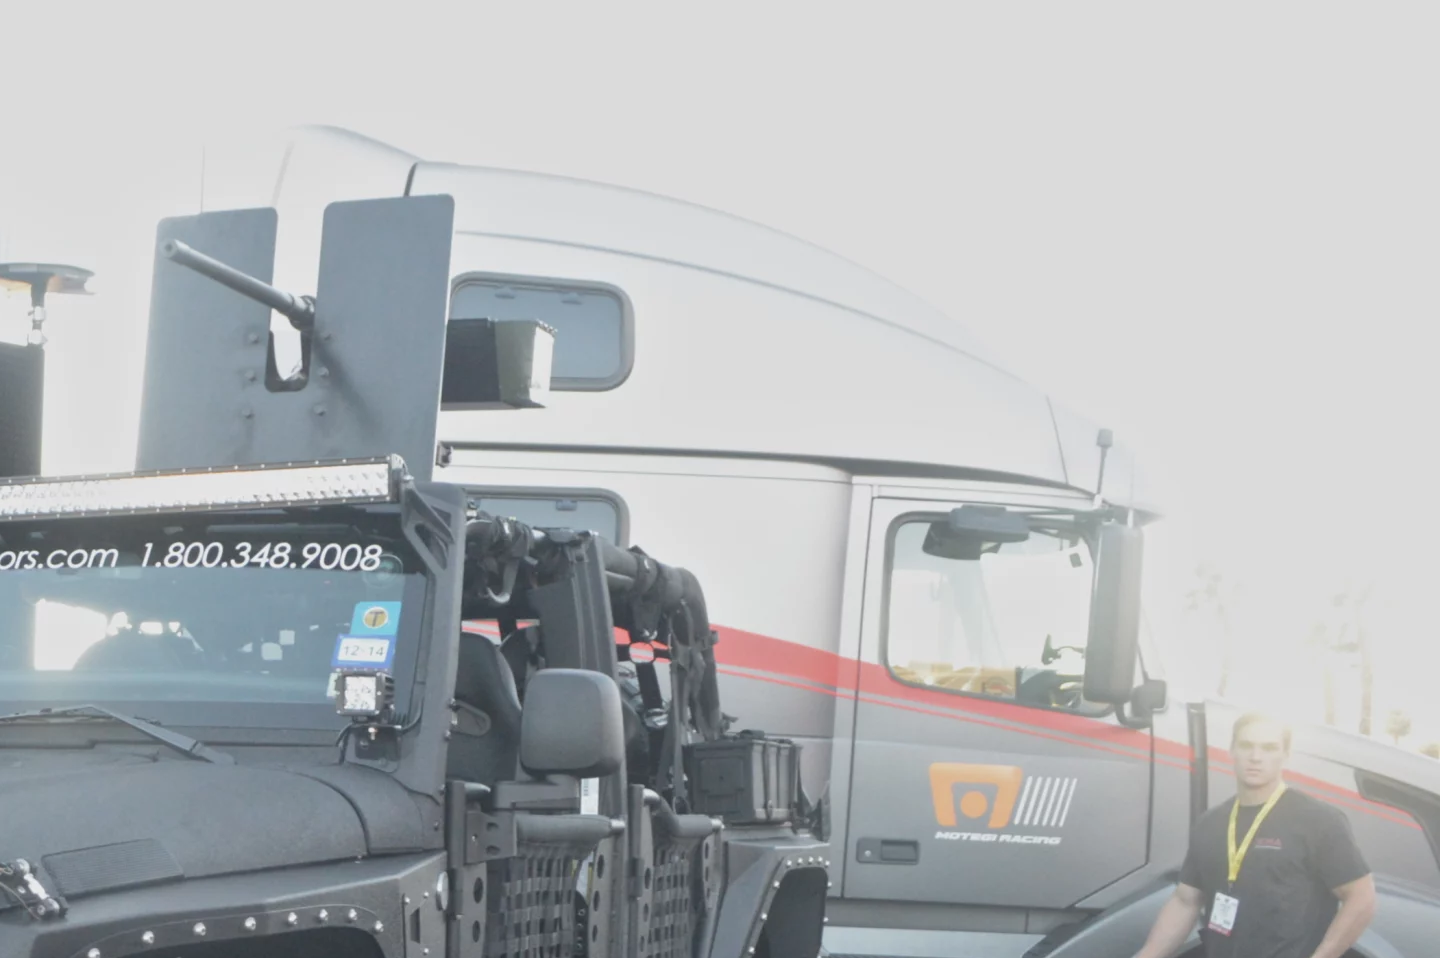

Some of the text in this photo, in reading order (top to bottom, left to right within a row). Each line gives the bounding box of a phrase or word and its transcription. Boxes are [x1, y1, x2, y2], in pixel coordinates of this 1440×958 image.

[141, 541, 383, 572] 1.800.348.9008
[934, 831, 1062, 845] MOTEGI RACING
